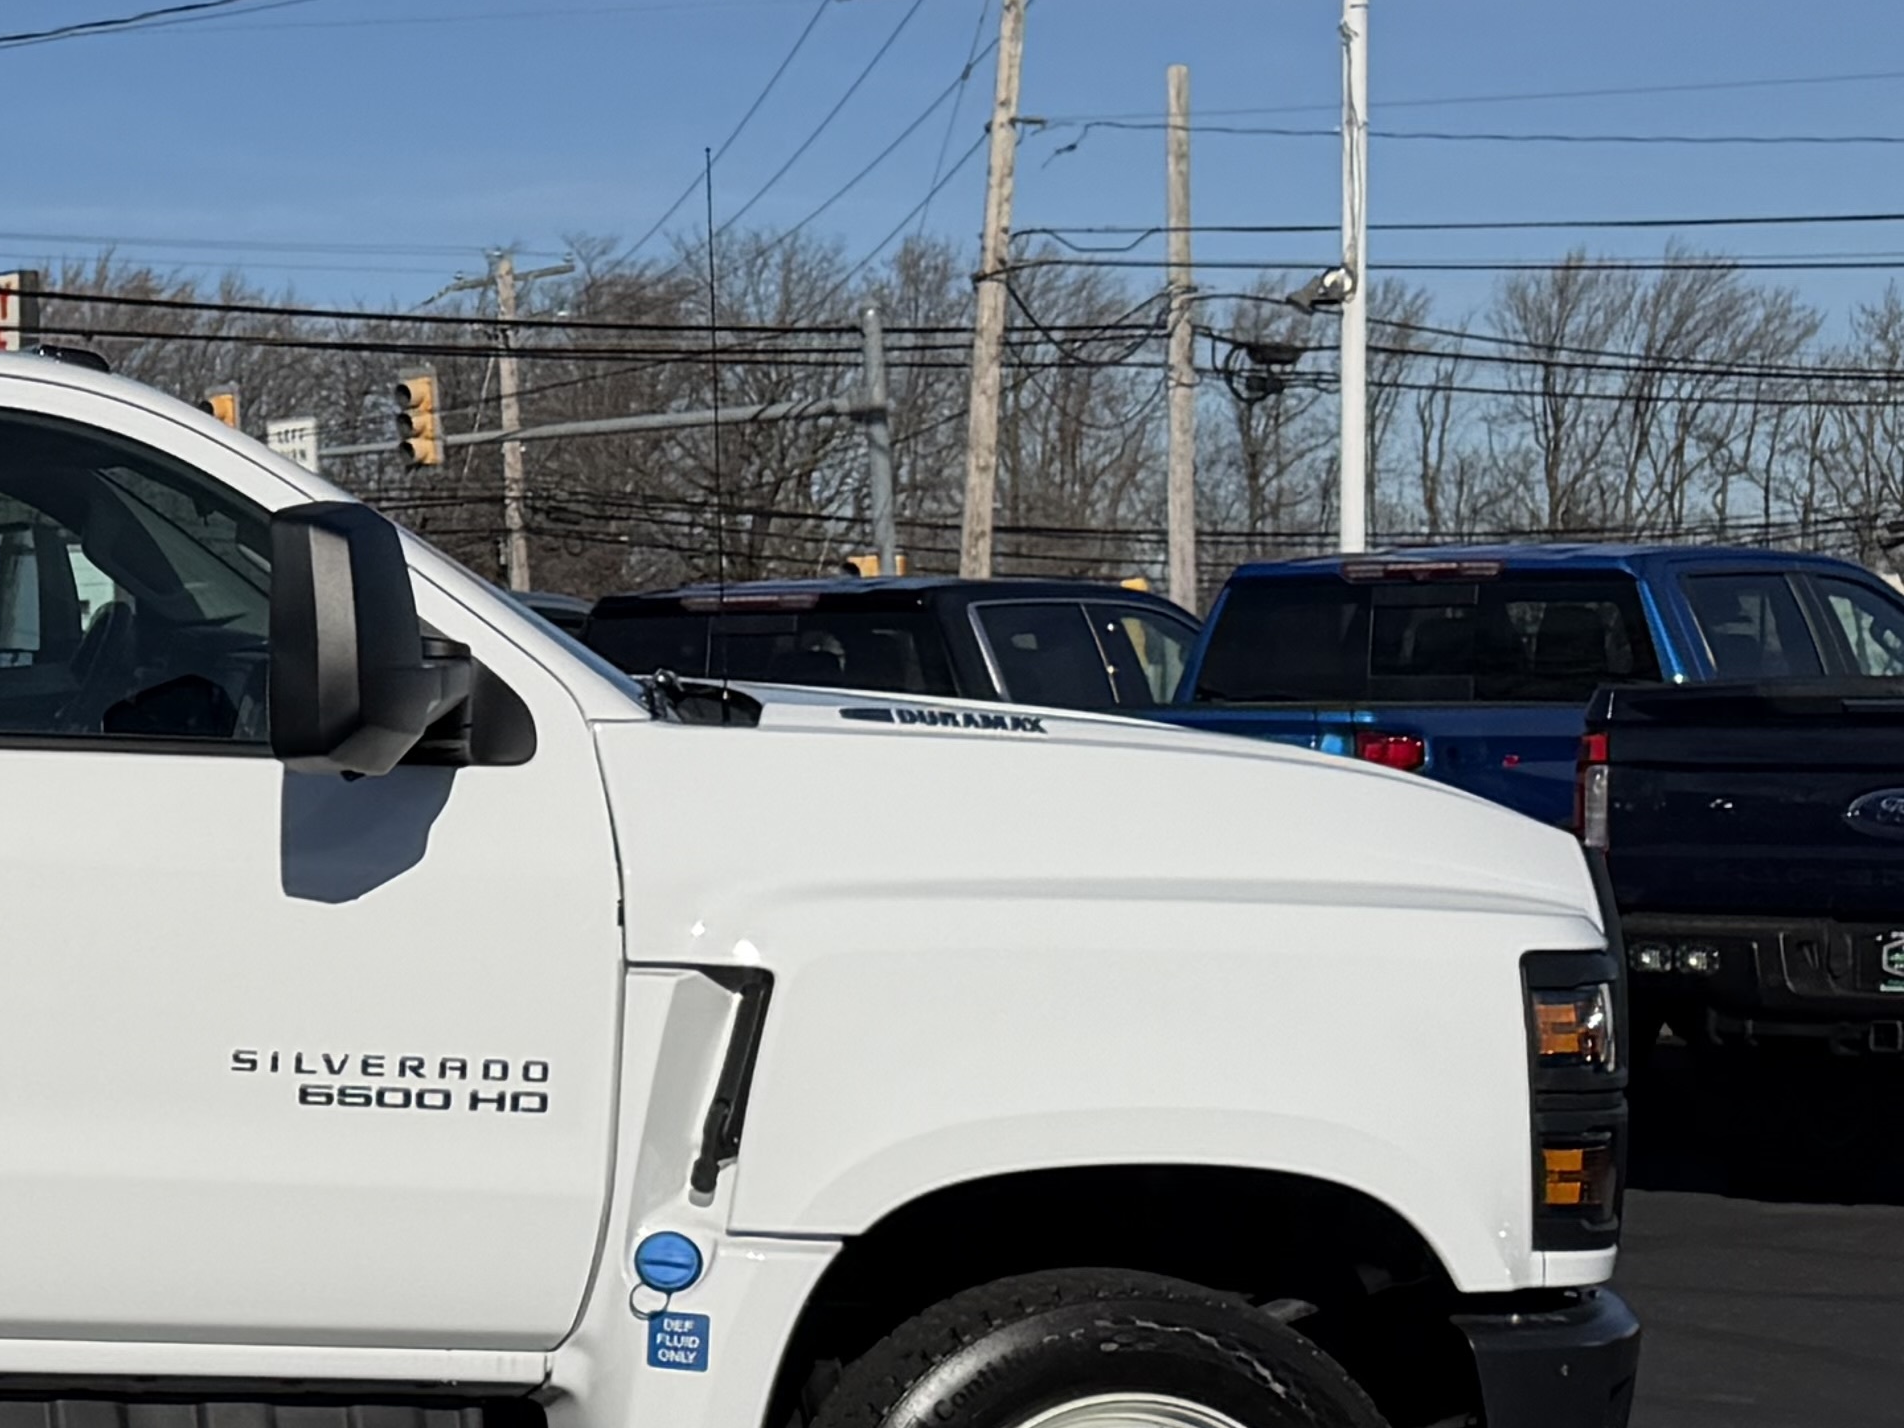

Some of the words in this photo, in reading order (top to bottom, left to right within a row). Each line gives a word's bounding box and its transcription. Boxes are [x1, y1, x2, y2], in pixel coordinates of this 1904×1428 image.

[895, 708, 1048, 734] DURAMAX
[230, 1049, 549, 1083] SILVERADO
[298, 1083, 452, 1111] 6500
[468, 1089, 549, 1114] HD
[663, 1318, 695, 1333] DEF
[656, 1333, 700, 1349] FLUID
[657, 1348, 697, 1364] ONLY
